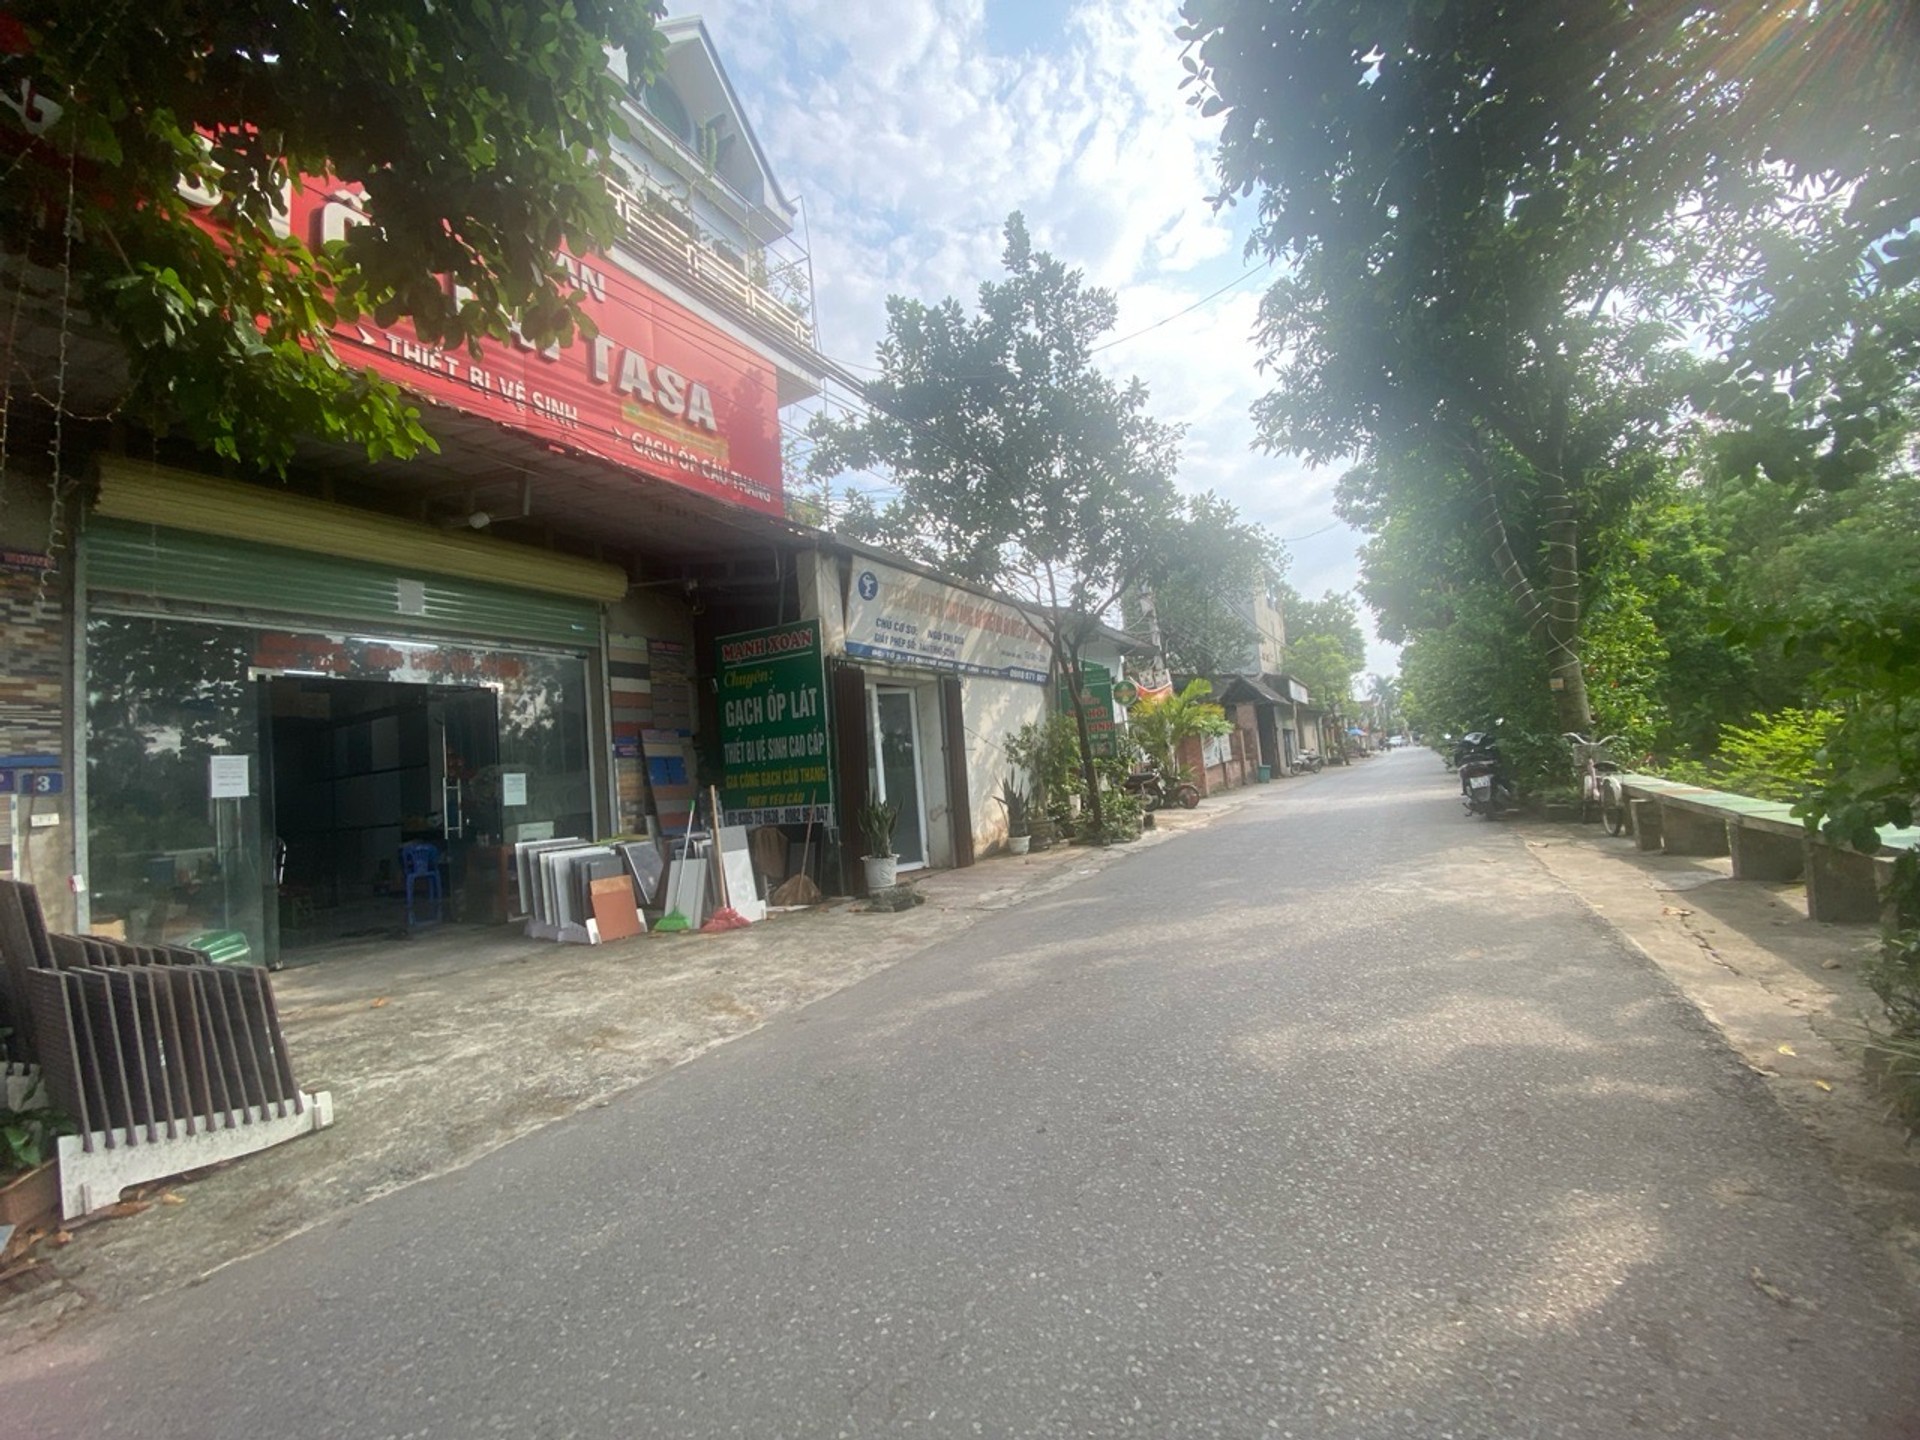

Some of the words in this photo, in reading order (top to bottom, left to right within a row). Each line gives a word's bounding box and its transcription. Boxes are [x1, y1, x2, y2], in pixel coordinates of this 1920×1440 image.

[587, 331, 718, 432] TASA
[531, 391, 578, 429] SINH
[722, 637, 767, 663] MẠNH
[768, 628, 813, 654] XOAN
[725, 695, 763, 732] GẠCH
[767, 684, 786, 722] ỐP
[790, 683, 817, 719] LÁT
[723, 736, 745, 765] THIẾT
[767, 737, 789, 761] SINH
[789, 734, 806, 758] CAO
[806, 724, 825, 756] CẤP
[37, 775, 51, 792] 3
